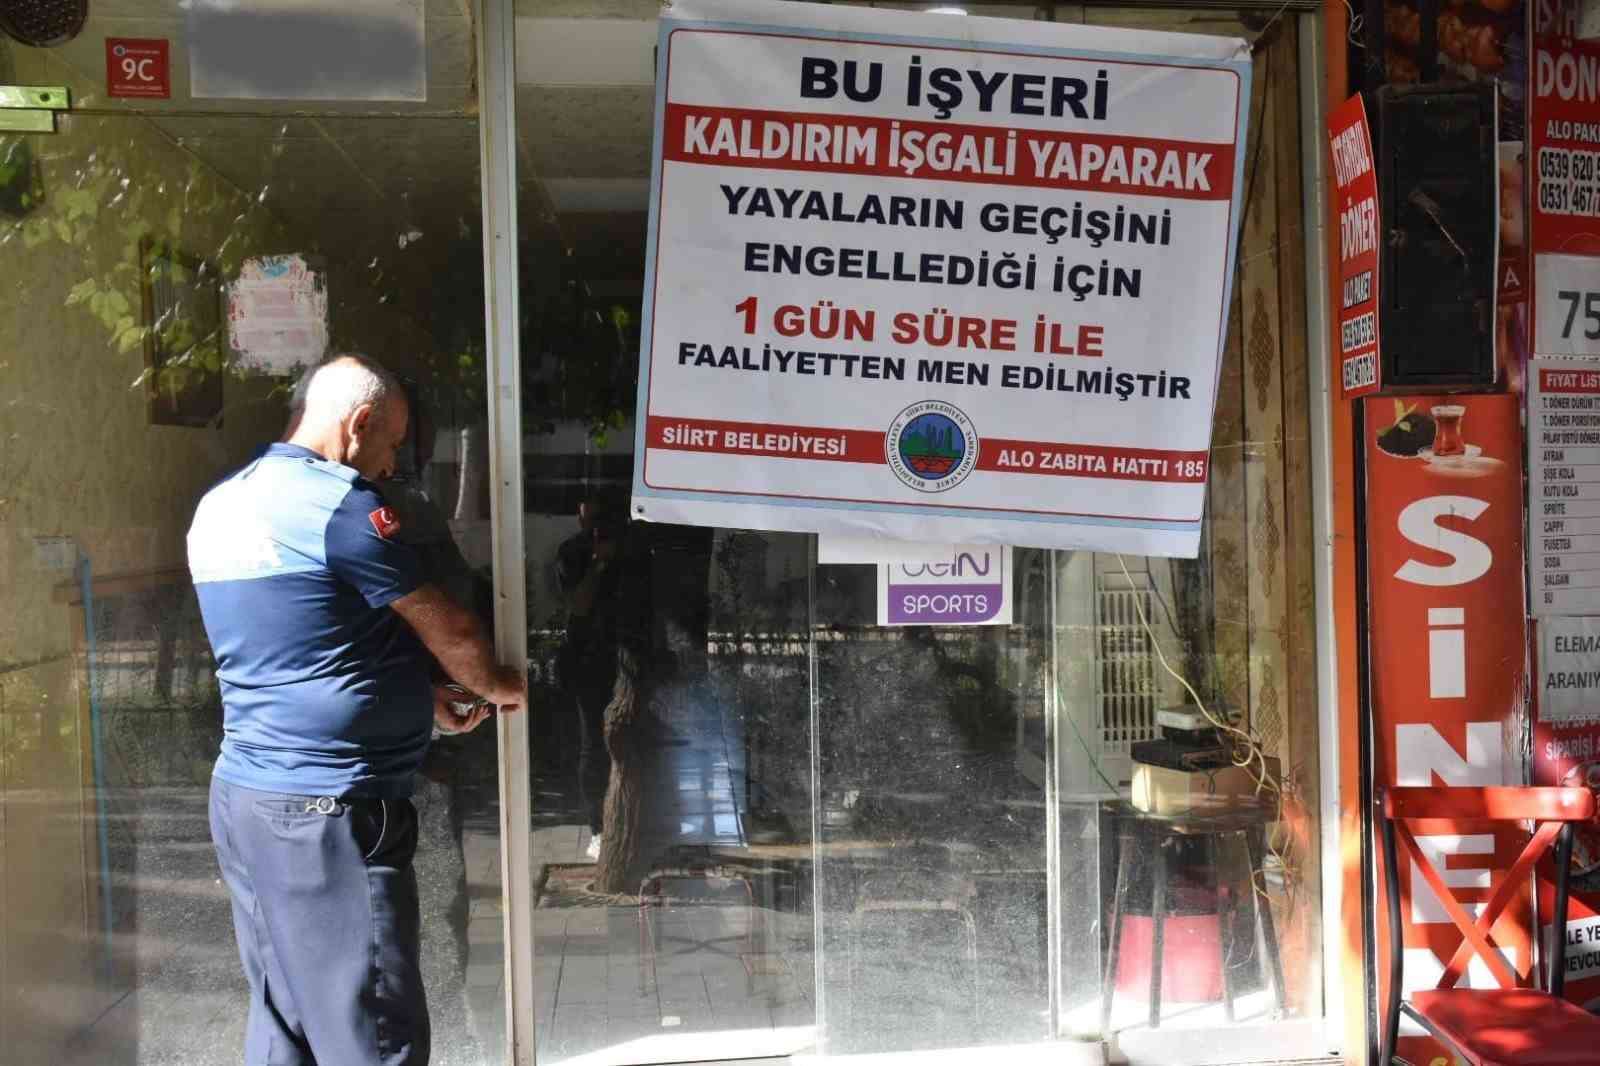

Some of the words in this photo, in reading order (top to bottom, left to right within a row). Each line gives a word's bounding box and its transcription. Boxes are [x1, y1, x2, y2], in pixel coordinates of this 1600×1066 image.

[121, 58, 155, 81] 9C
[800, 57, 883, 102] BU
[907, 55, 1109, 120] İŞYERİ
[1537, 39, 1600, 102] DÖN
[683, 115, 877, 166] KALDIRIM
[888, 121, 1017, 176] İŞGALİ
[1028, 140, 1213, 192] YAPARAK
[1547, 120, 1571, 139] ALO
[1574, 122, 1600, 142] PAK
[1541, 151, 1569, 178] 0539
[1573, 154, 1593, 180] 620
[720, 184, 964, 229] YAYALARIN
[980, 202, 1172, 248] GEÇİŞİNİ
[1541, 182, 1568, 209] 0531
[1572, 184, 1593, 212] 467
[744, 242, 1037, 290] ENGELLEDİĞİ
[1053, 256, 1141, 301] İÇİN
[735, 297, 758, 335] 1
[774, 301, 875, 342] GÜN
[891, 308, 1017, 351] SÜRE
[1034, 314, 1104, 357] İLE
[1558, 291, 1600, 340] 75
[678, 342, 905, 381] FAALİYETTEN
[917, 359, 989, 386] MEN
[1001, 363, 1191, 401] EDİLMİŞTİR
[662, 426, 718, 446] SİİRT
[724, 432, 847, 456] BELEDİYESİ
[997, 449, 1034, 467] ALO
[1040, 452, 1107, 473] ZABITA
[1112, 458, 1168, 476] HATTI
[1175, 460, 1204, 477] 185
[903, 595, 988, 613] SPORTS
